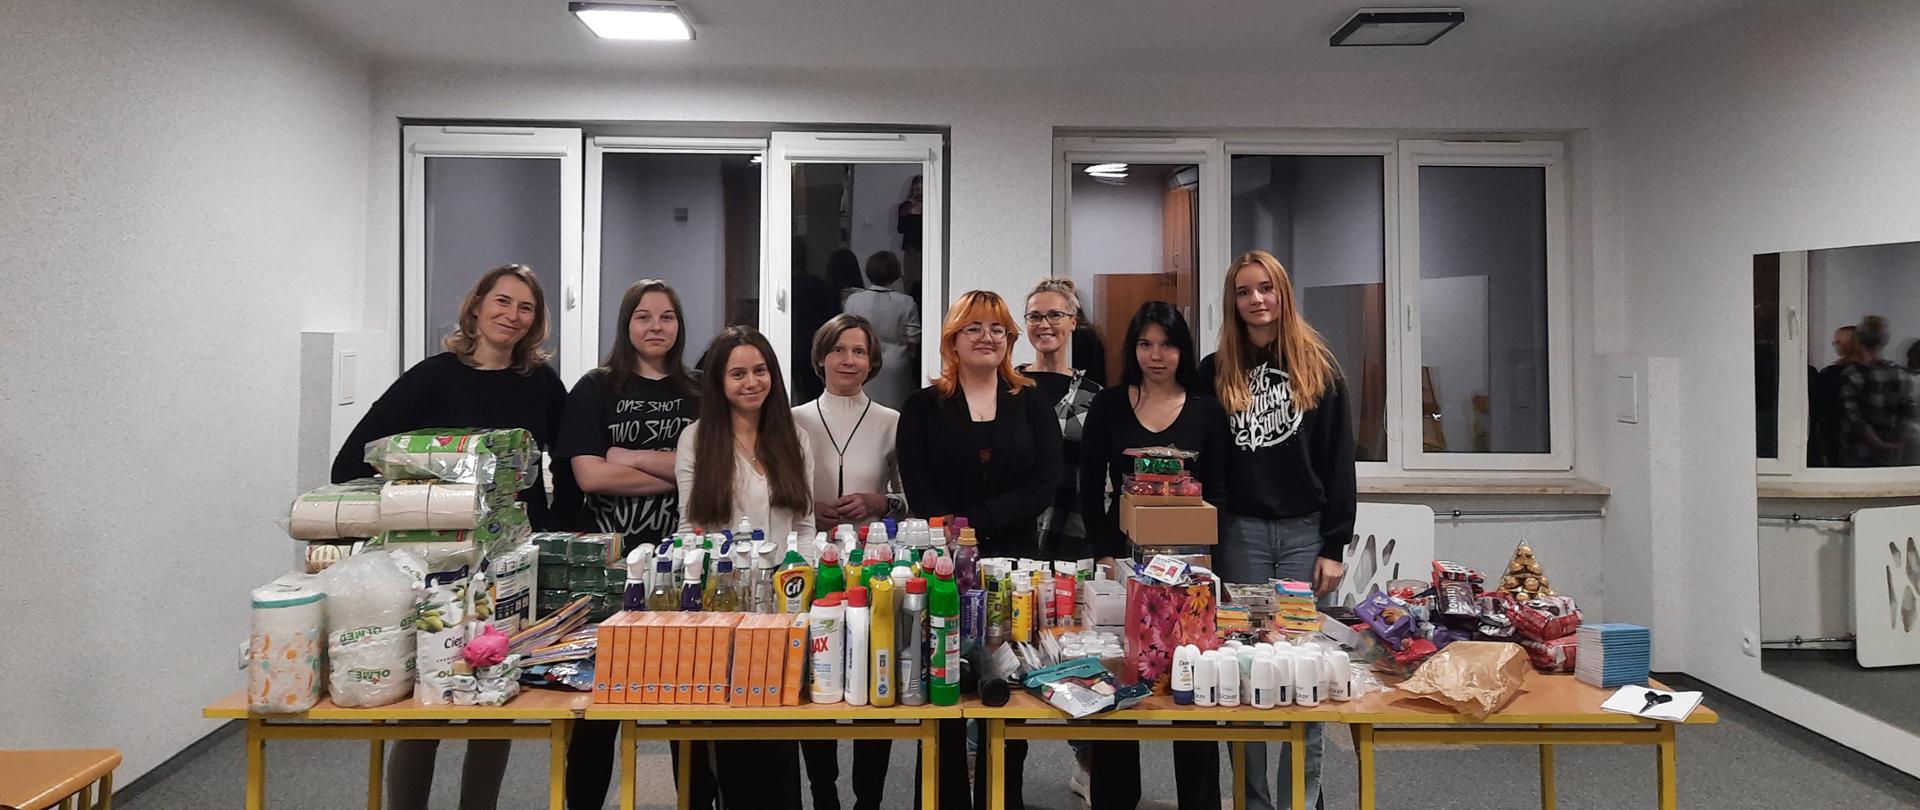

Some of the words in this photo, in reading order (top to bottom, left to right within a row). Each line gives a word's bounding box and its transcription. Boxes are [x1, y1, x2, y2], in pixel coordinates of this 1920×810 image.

[616, 399, 645, 414] ONE
[646, 398, 685, 414] SHOT
[608, 420, 641, 445] TWO
[785, 578, 803, 597] Cif
[810, 636, 829, 655] JAX
